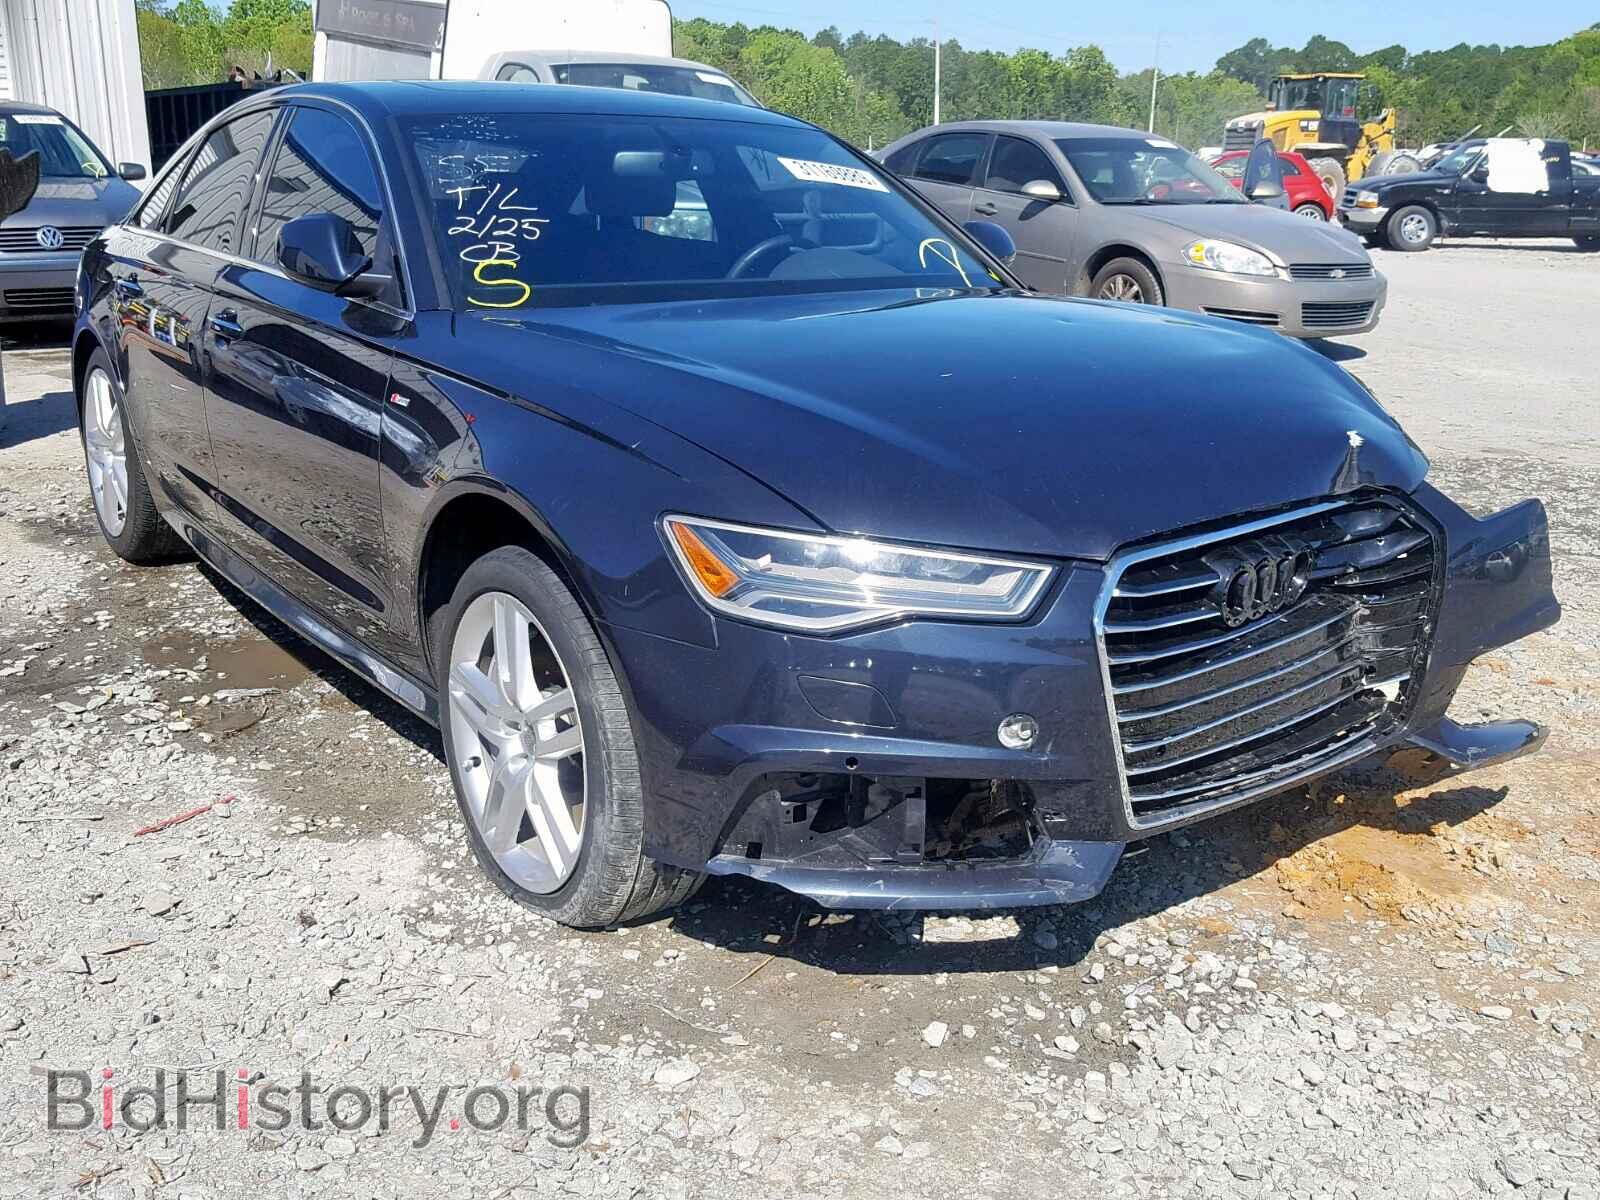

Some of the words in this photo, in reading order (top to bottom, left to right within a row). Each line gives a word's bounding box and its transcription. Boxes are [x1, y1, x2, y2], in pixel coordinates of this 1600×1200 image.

[445, 183, 538, 215] T/L
[448, 215, 549, 240] 2/25
[467, 260, 532, 308] S
